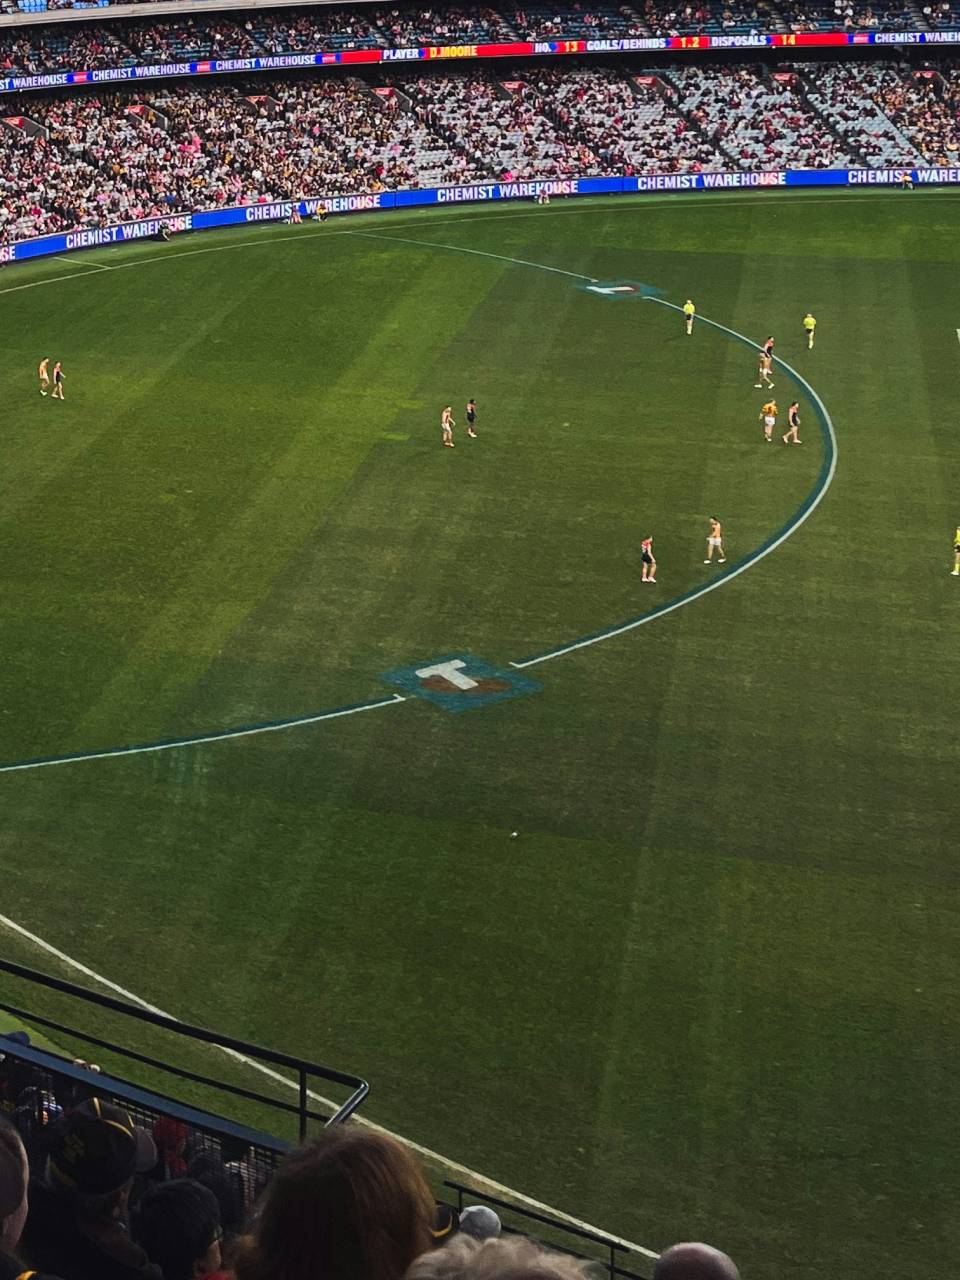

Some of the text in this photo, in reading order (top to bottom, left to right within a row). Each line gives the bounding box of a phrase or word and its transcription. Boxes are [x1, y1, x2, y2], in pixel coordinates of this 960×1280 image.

[383, 48, 419, 59] PLAYER
[430, 46, 477, 58] D.MOORE
[565, 41, 577, 52] 13
[587, 37, 665, 50] GOALS/BEHINDS
[681, 37, 699, 47] 1.2
[711, 35, 766, 46] DISPOSALS
[782, 35, 795, 45] 14
[874, 33, 920, 43] CHEMIST
[13, 73, 67, 88] WAREHOUSE
[92, 67, 131, 81] CHEMIST
[136, 63, 190, 77] WAREHOUSE
[216, 58, 255, 70] CHEMIST
[259, 54, 315, 67] WAREHOUSE
[66, 226, 118, 248] CHEMIST
[438, 185, 494, 202] CHEMIST
[499, 181, 578, 198] WAREHOUSE
[638, 175, 698, 190] CHEMIST
[702, 172, 786, 187] WAREHOUSE
[917, 169, 960, 182] WARE
